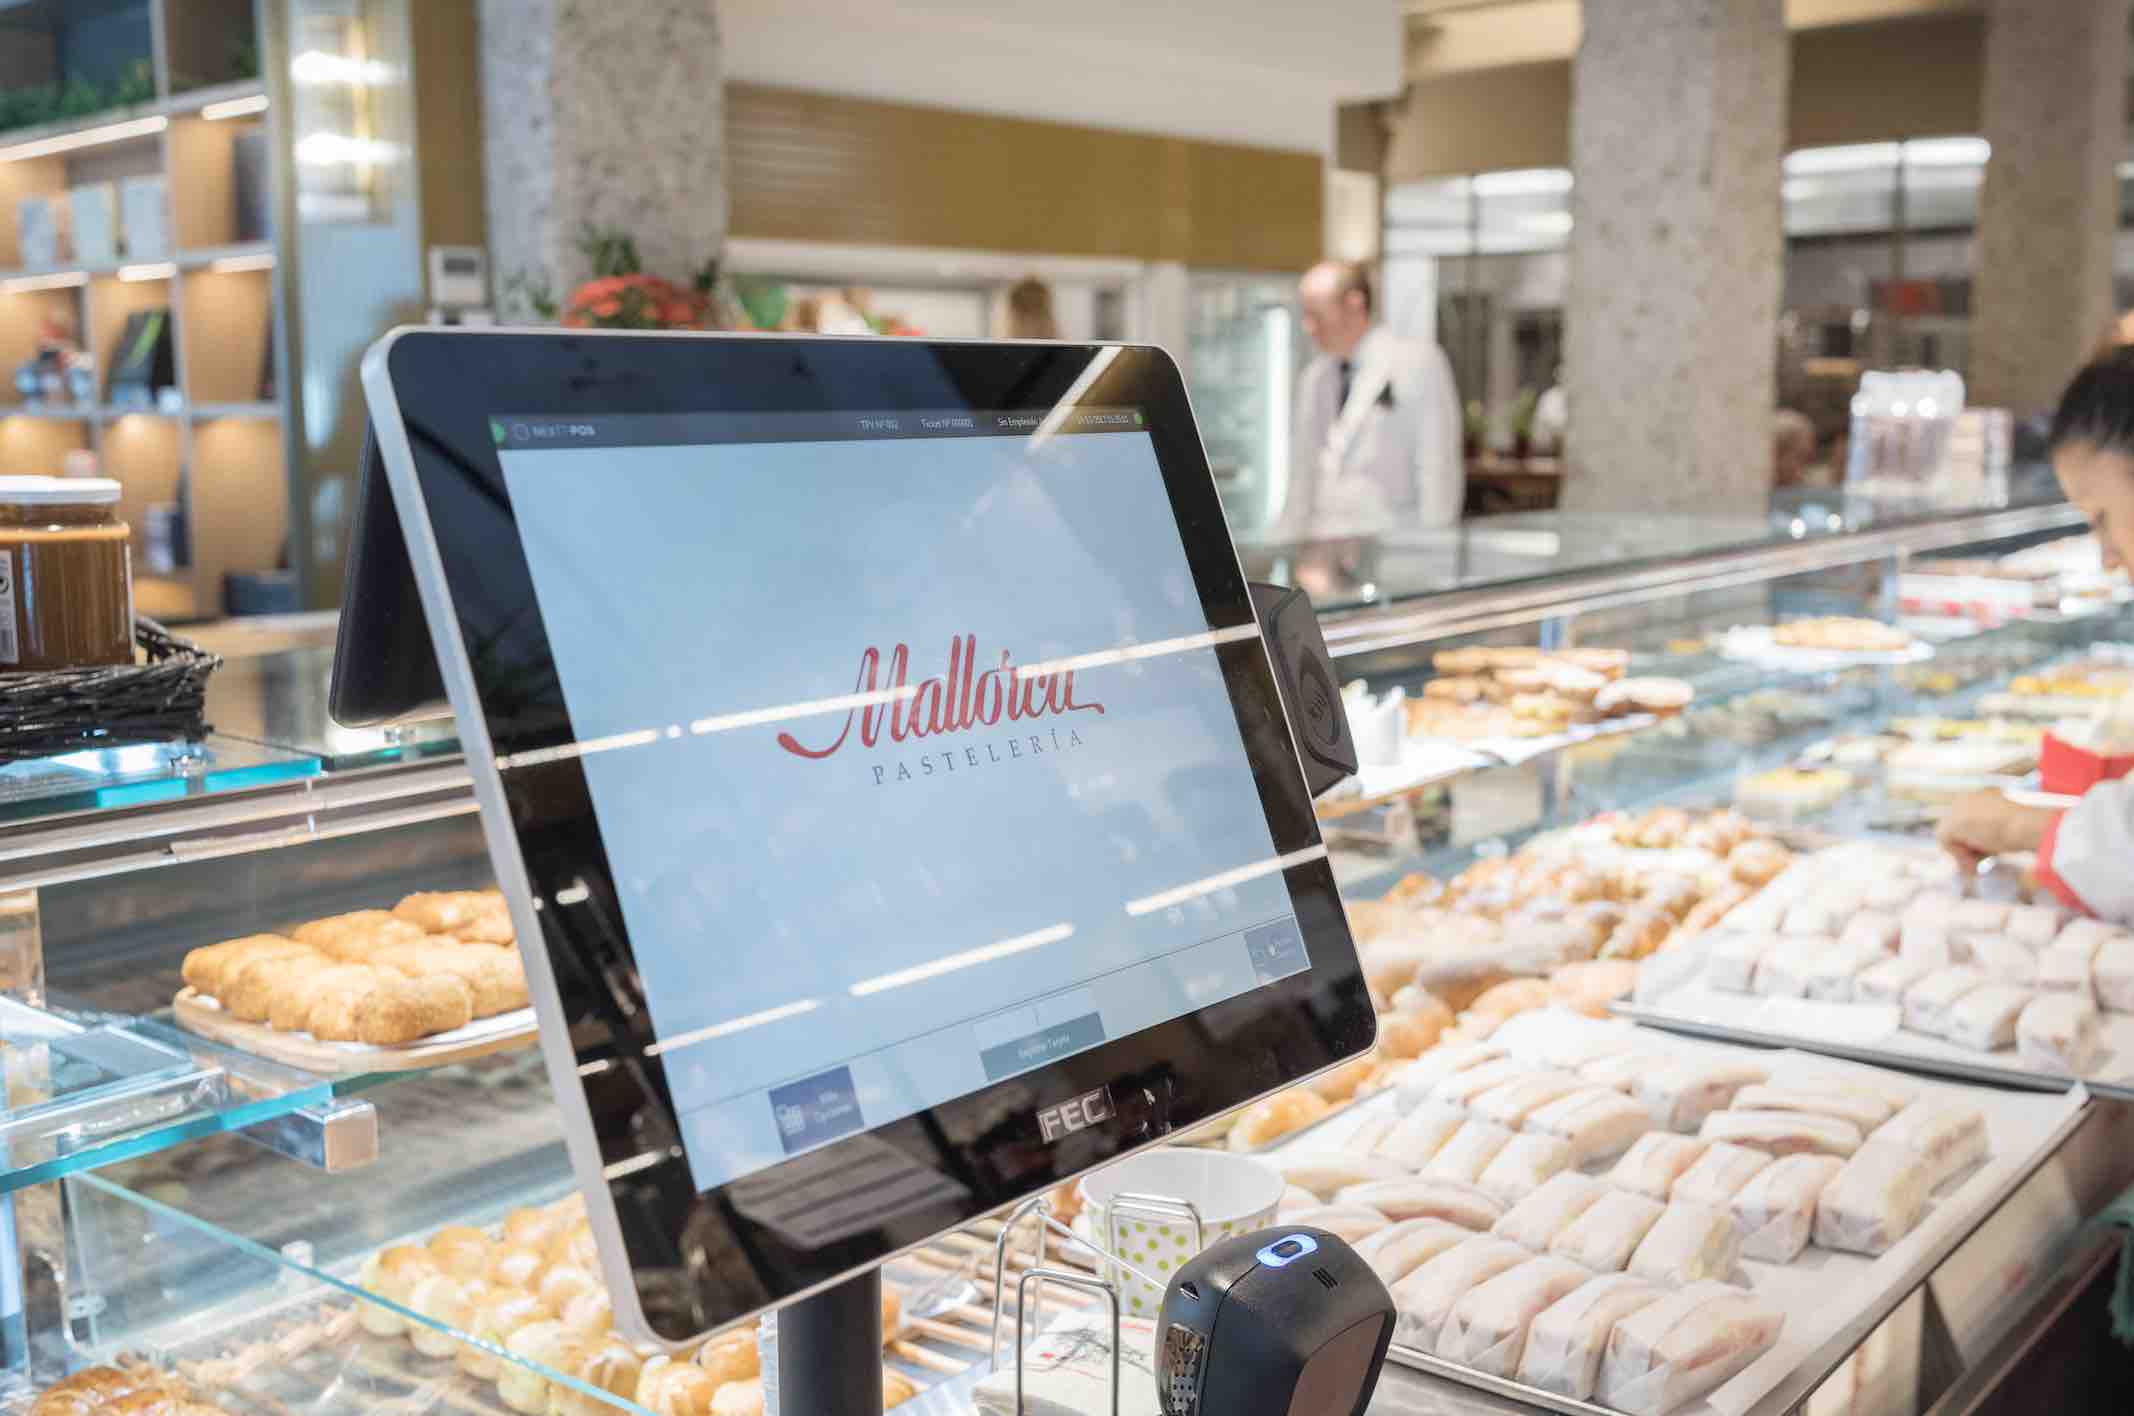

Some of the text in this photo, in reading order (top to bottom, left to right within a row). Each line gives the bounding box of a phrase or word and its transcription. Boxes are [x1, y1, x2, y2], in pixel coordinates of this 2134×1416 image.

[777, 633, 1105, 759] Mallorca
[871, 727, 1083, 786] PASTELERÍA
[1037, 1090, 1106, 1145] FEC
